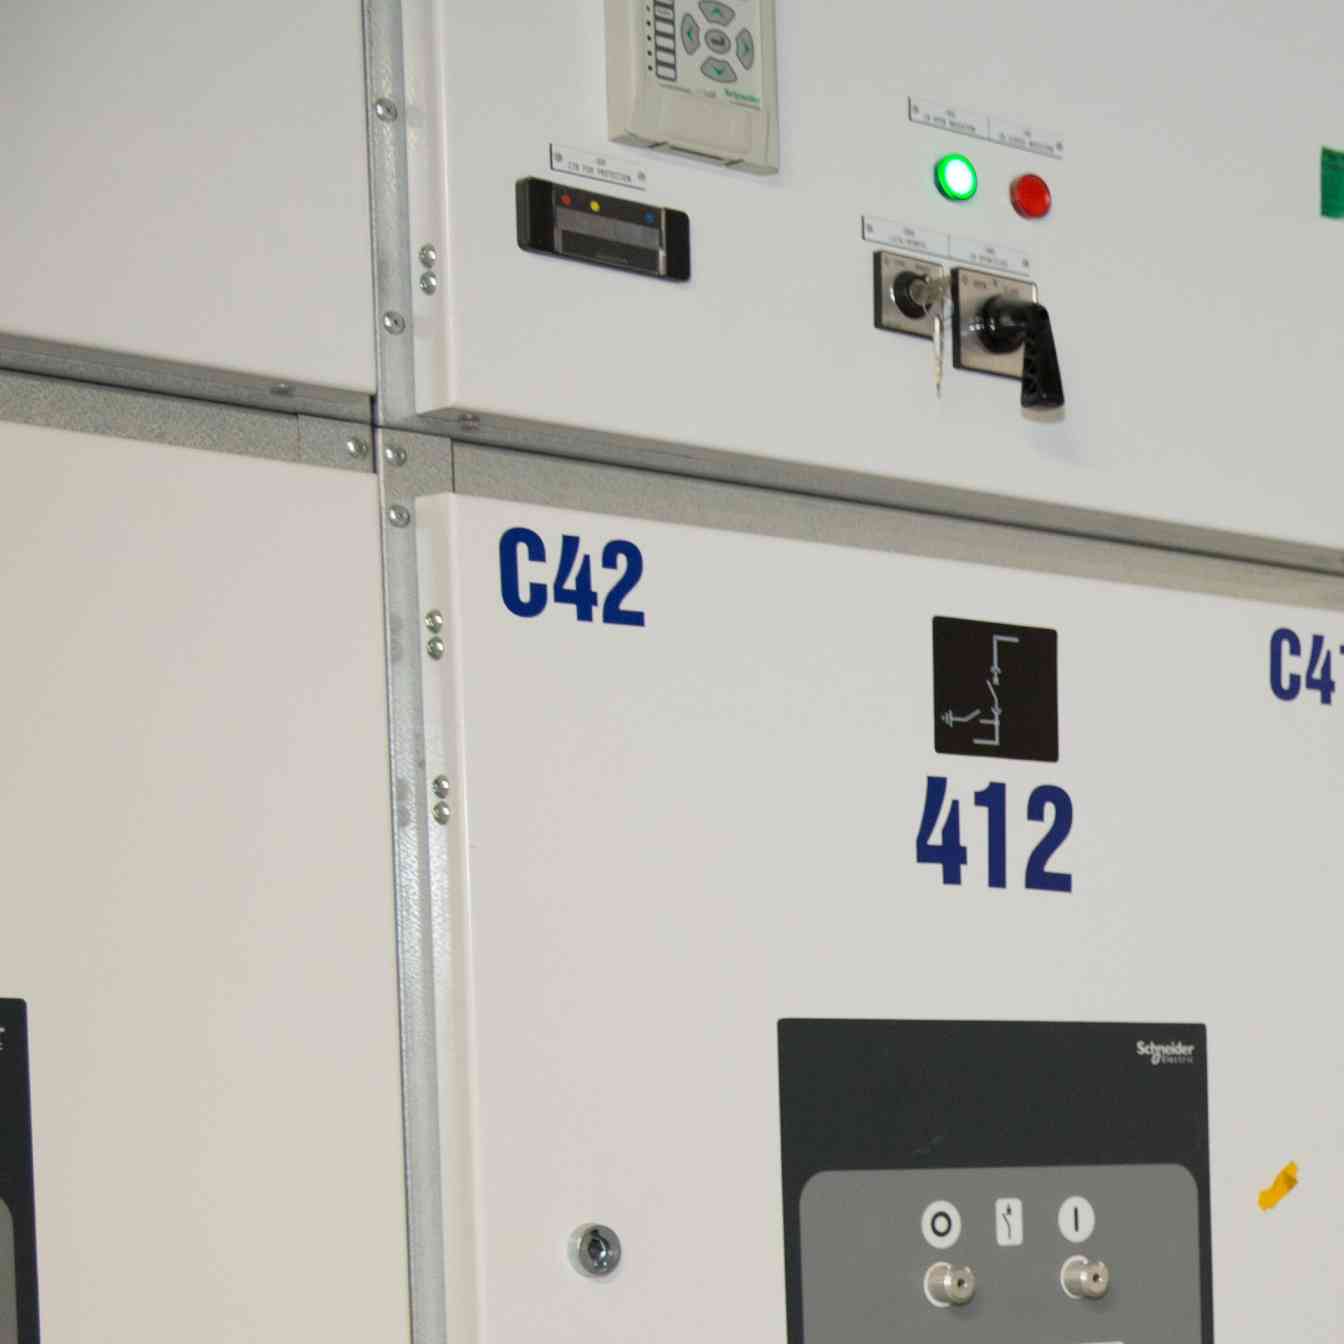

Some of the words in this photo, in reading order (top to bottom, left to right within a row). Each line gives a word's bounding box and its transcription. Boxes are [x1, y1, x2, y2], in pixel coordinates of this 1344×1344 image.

[498, 526, 646, 628] C42
[916, 775, 1074, 894] 412
[1136, 1039, 1195, 1065] Schneider
